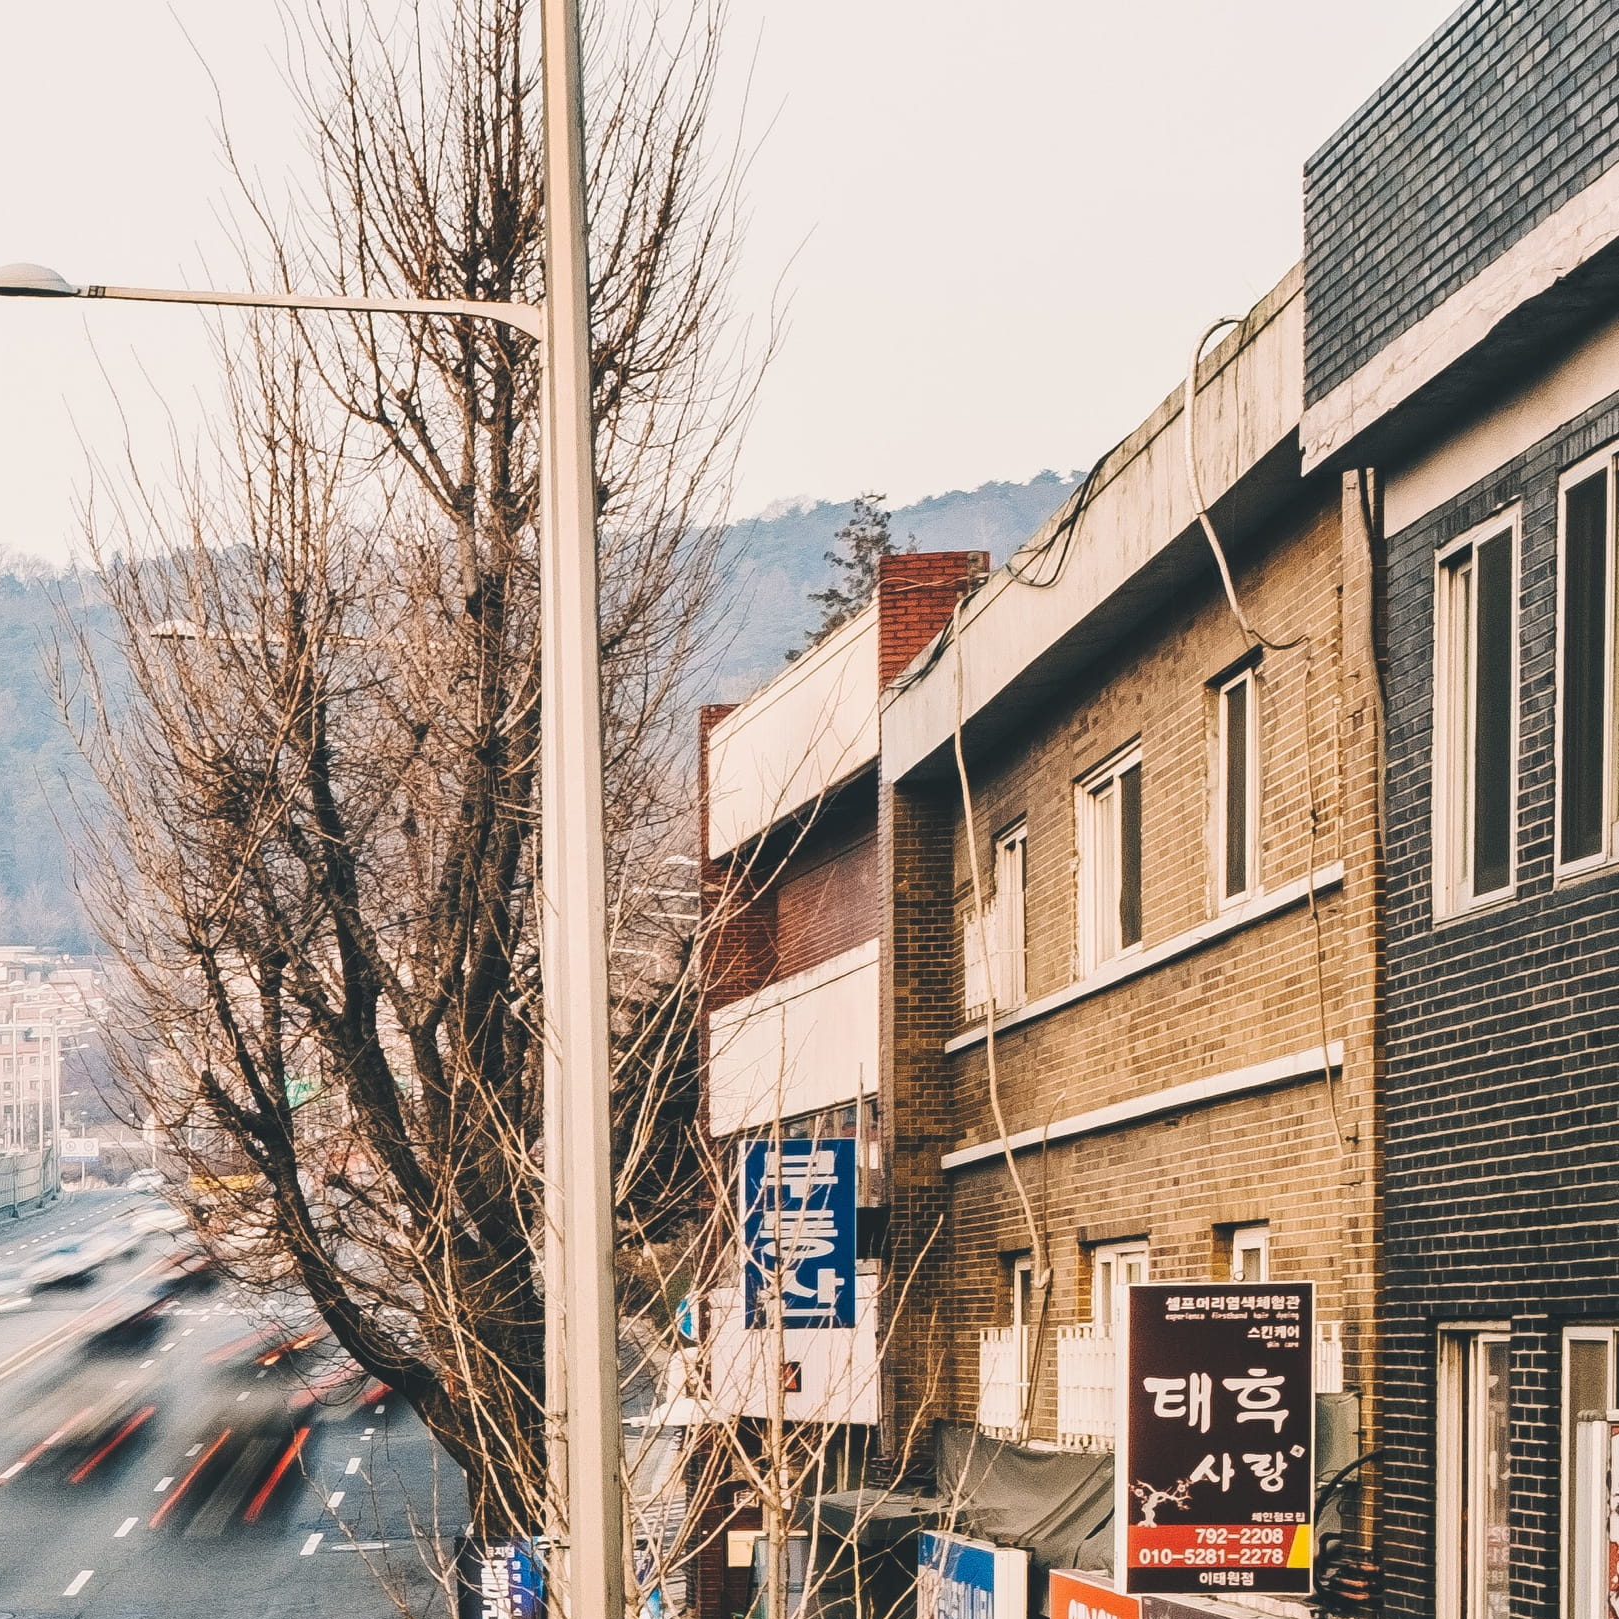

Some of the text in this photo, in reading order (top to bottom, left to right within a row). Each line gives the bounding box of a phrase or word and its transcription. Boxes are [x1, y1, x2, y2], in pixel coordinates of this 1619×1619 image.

[1247, 1324, 1300, 1340] 스킨케어
[1190, 1451, 1288, 1493] 사랑
[1195, 1528, 1284, 1545] 792-2208
[1139, 1548, 1284, 1565] 010-5281-2278
[1199, 1571, 1255, 1587] 이태원점
